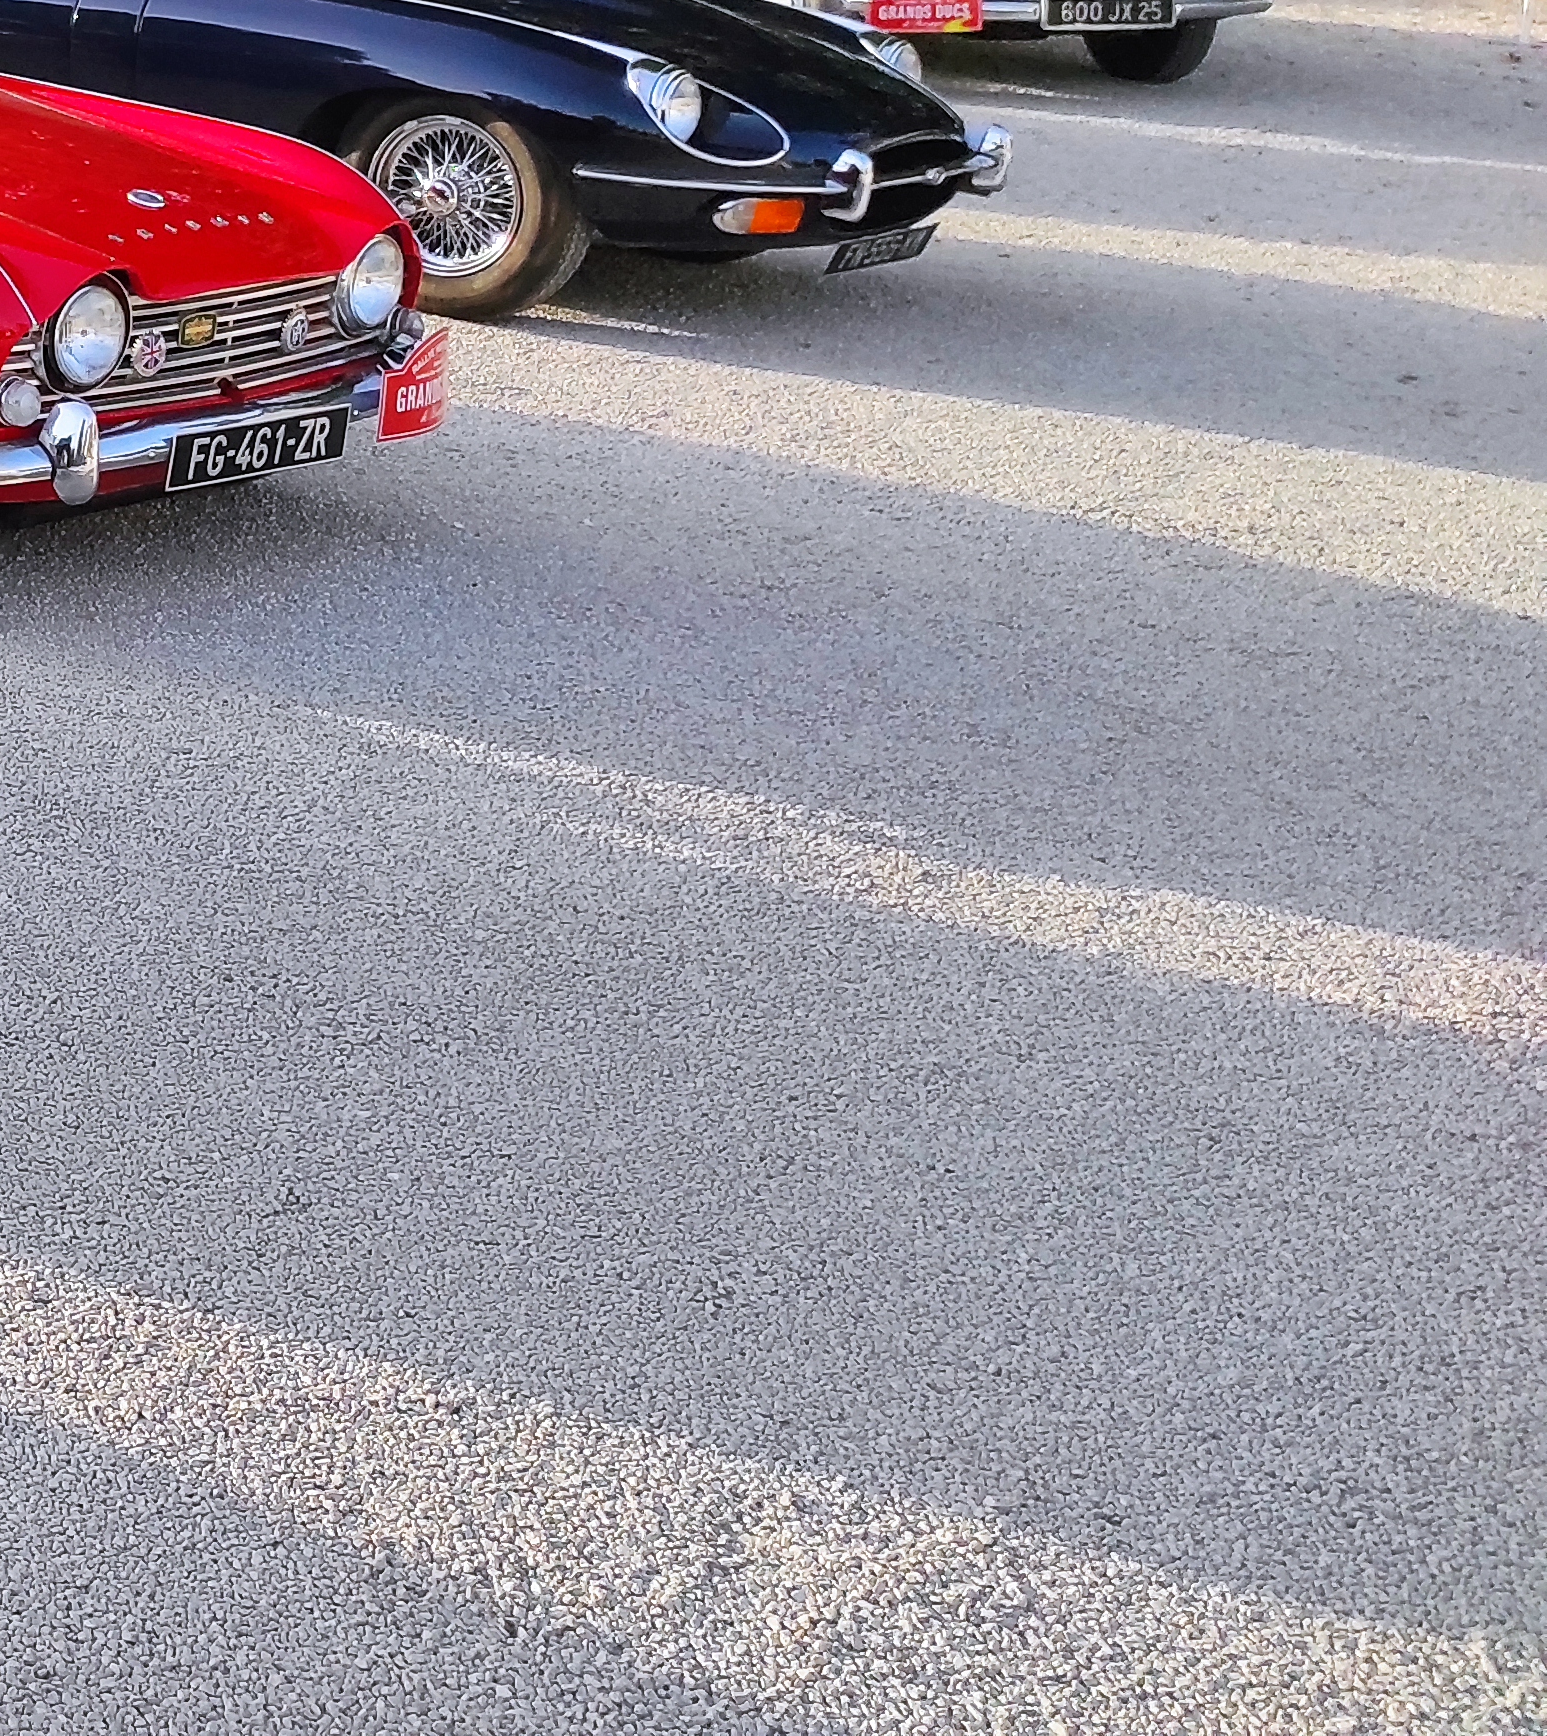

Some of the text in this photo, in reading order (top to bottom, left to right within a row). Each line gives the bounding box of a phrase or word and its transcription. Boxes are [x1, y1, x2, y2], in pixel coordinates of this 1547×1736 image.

[878, 4, 932, 21] GRANDS
[1061, 0, 1162, 22] 600 JX 25
[187, 416, 334, 481] FG-461-ZR
